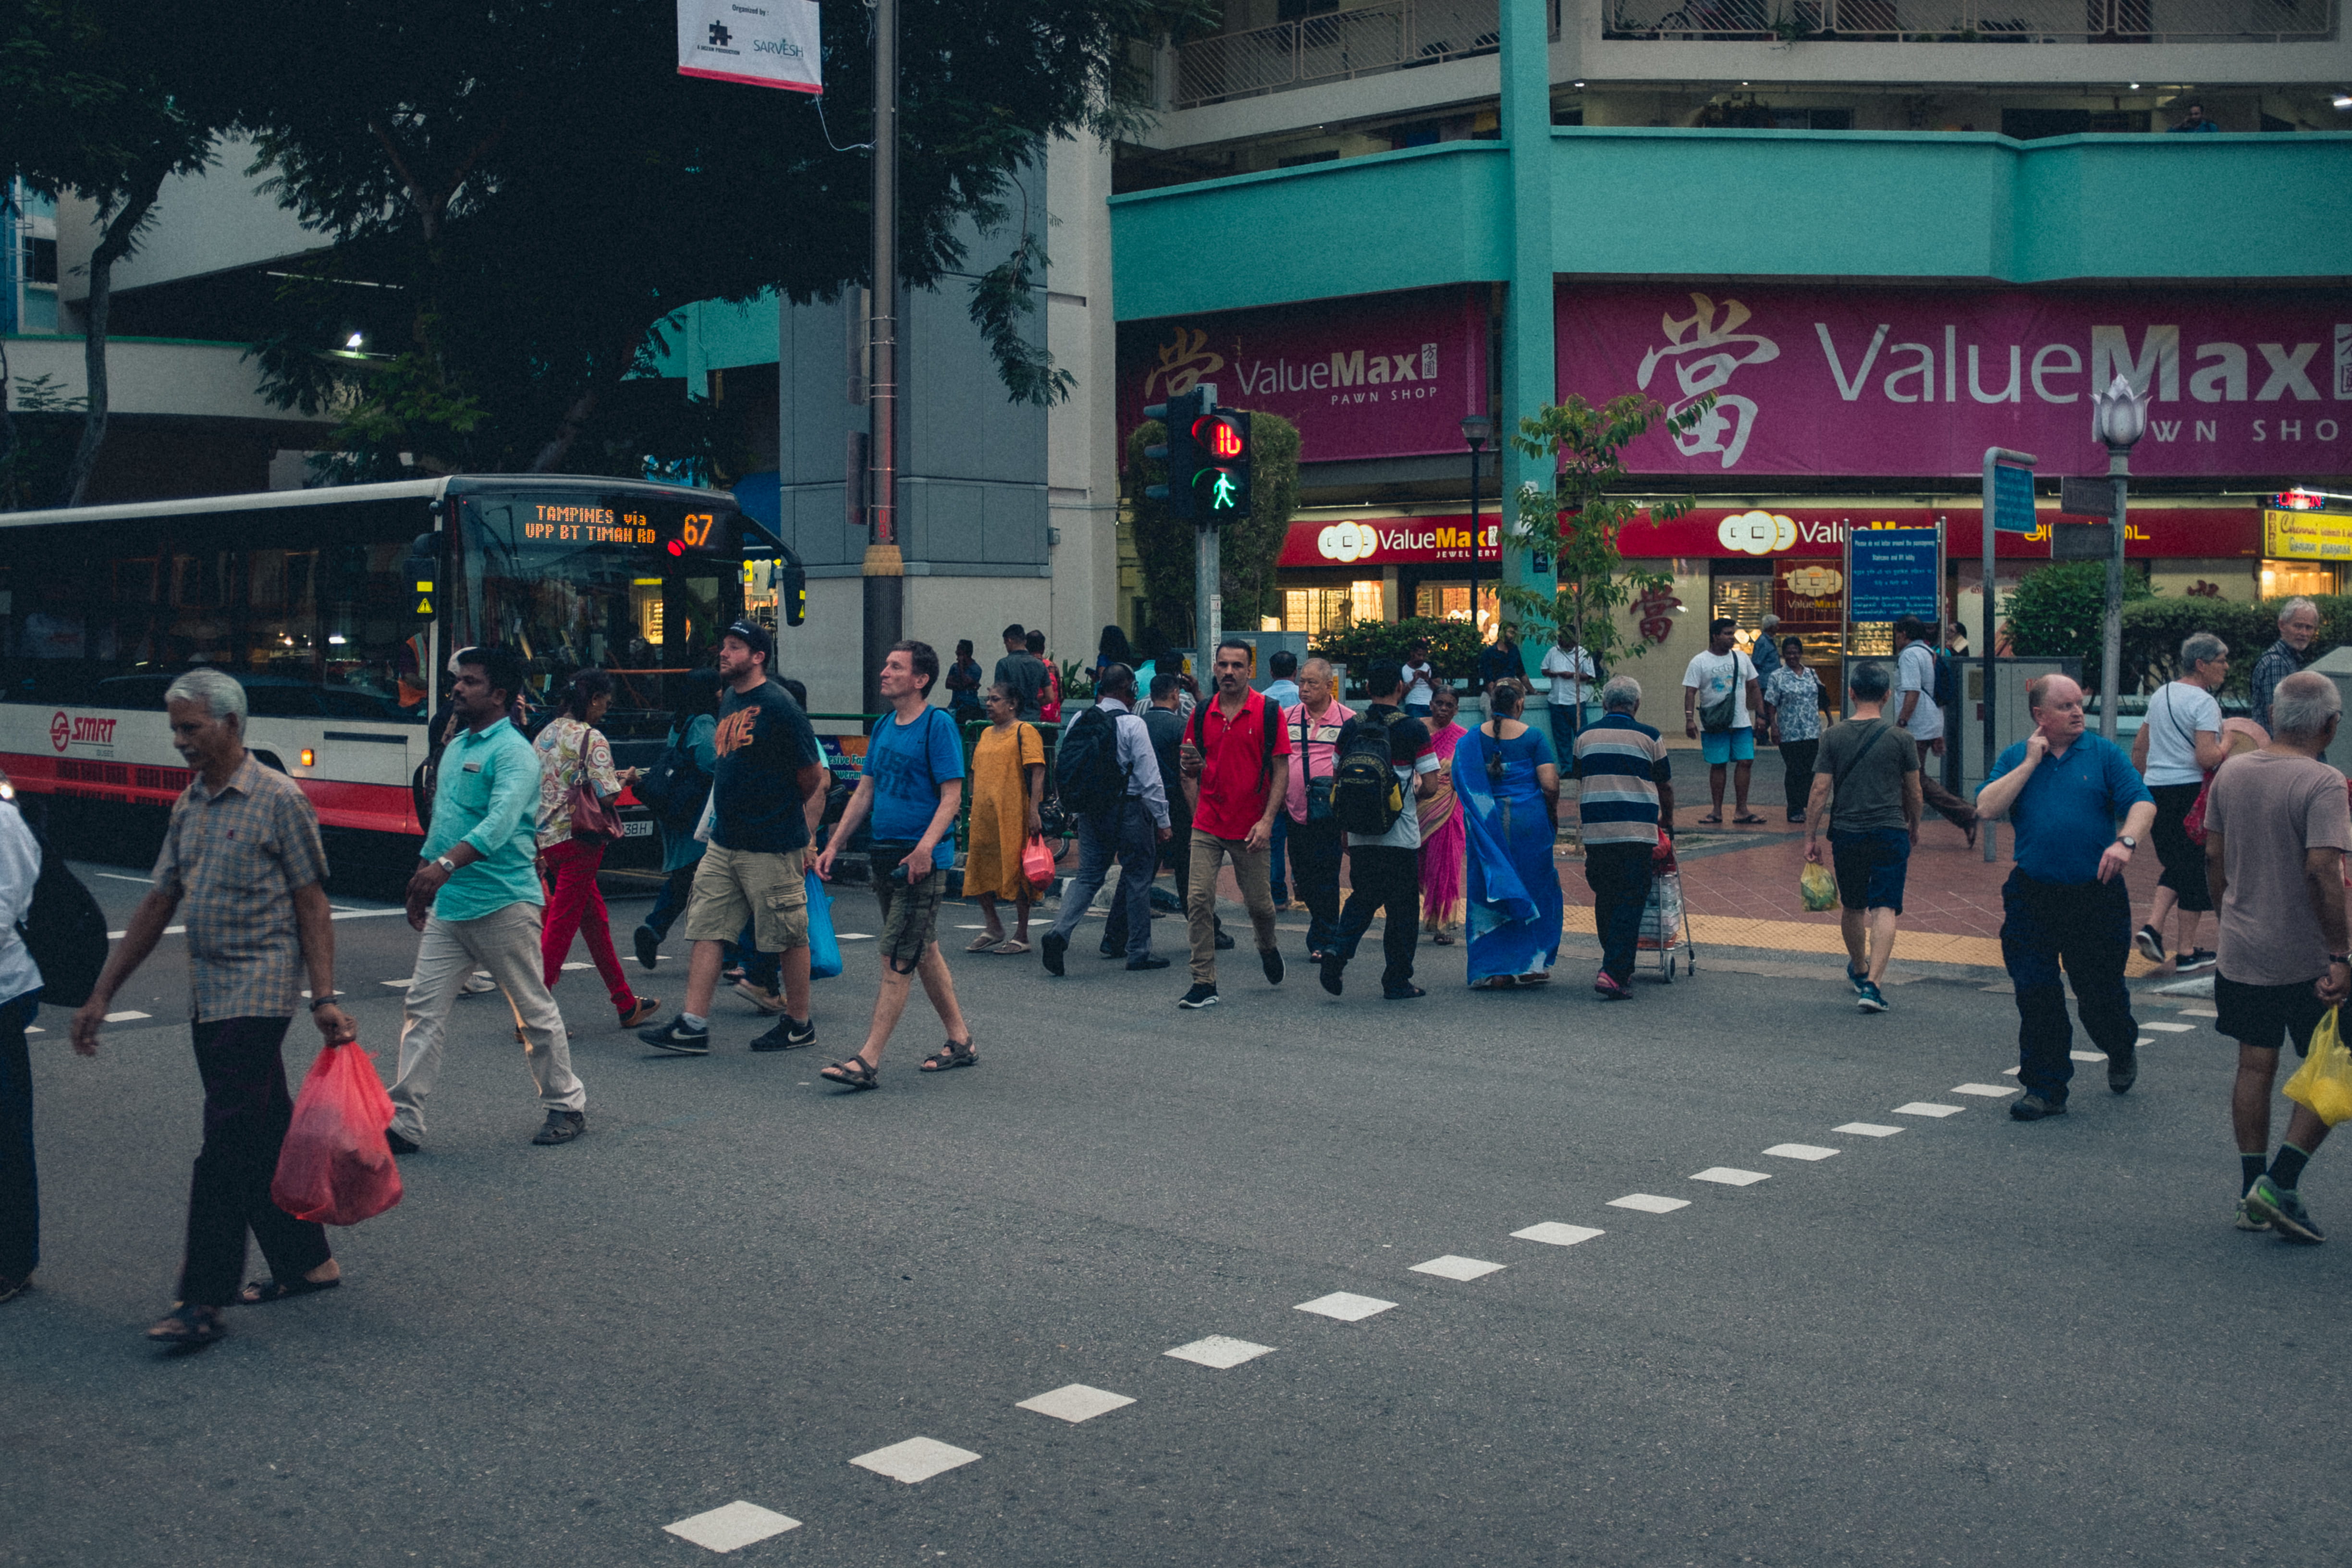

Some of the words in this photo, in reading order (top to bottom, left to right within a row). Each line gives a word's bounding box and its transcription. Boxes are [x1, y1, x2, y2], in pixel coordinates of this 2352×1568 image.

[732, 4, 758, 14] Organized
[715, 47, 740, 55] PRODUCTION
[753, 39, 804, 57] SARVESH
[1235, 349, 1419, 396] ValueMax
[1814, 324, 2321, 404] ValueMax
[1331, 391, 1379, 406] PAWN
[1391, 386, 1438, 401] SHOP
[536, 504, 614, 524] TAMPINES
[623, 511, 647, 526] via
[525, 523, 553, 539] UPP
[560, 524, 579, 540] BT
[586, 526, 632, 543] TIMAH
[637, 528, 656, 544] RD
[684, 514, 713, 547] 67
[1436, 550, 1497, 558] JEWELERY
[1788, 600, 1838, 609] ValueMax
[71, 717, 116, 742] SMRT
[622, 822, 647, 834] 38H
